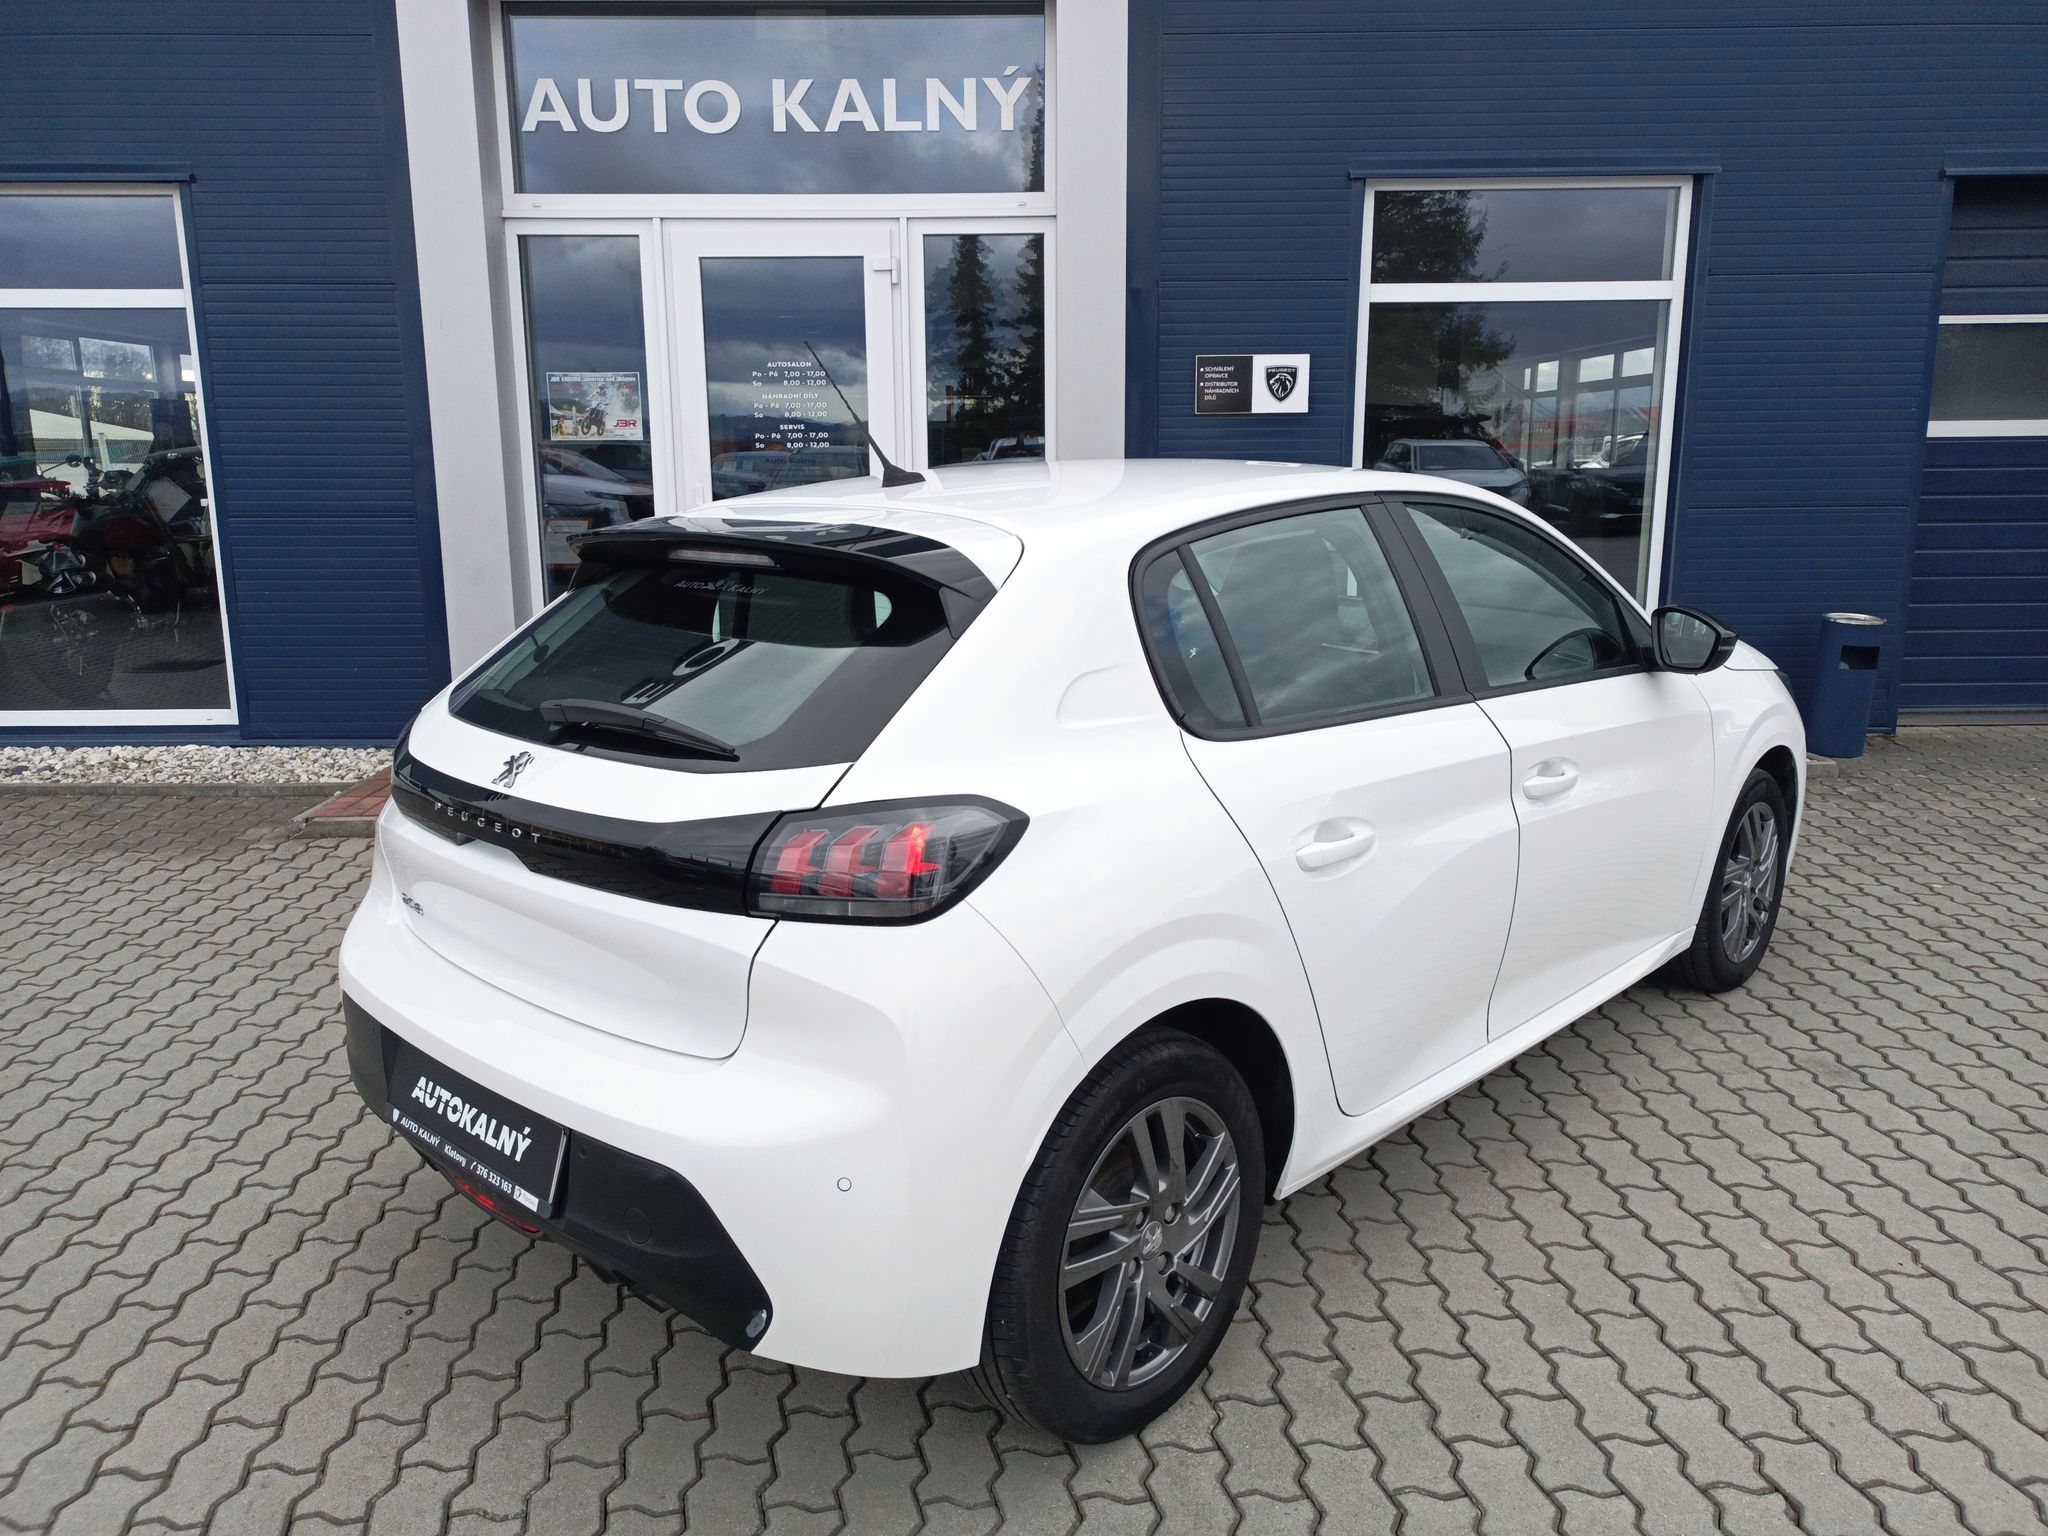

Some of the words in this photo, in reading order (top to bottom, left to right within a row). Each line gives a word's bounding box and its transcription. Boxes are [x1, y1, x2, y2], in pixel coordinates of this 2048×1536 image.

[521, 77, 741, 135] AUTO
[772, 65, 1033, 133] KALNÝ
[614, 419, 637, 428] JBR
[434, 801, 542, 844] PEUGEOT
[411, 1076, 532, 1162] AUTOKALNÝ
[400, 1117, 419, 1133] AUTO
[418, 1127, 440, 1148] KALNÝ
[476, 1164, 488, 1179] 376
[489, 1172, 500, 1186] 323
[501, 1179, 513, 1193] 163
